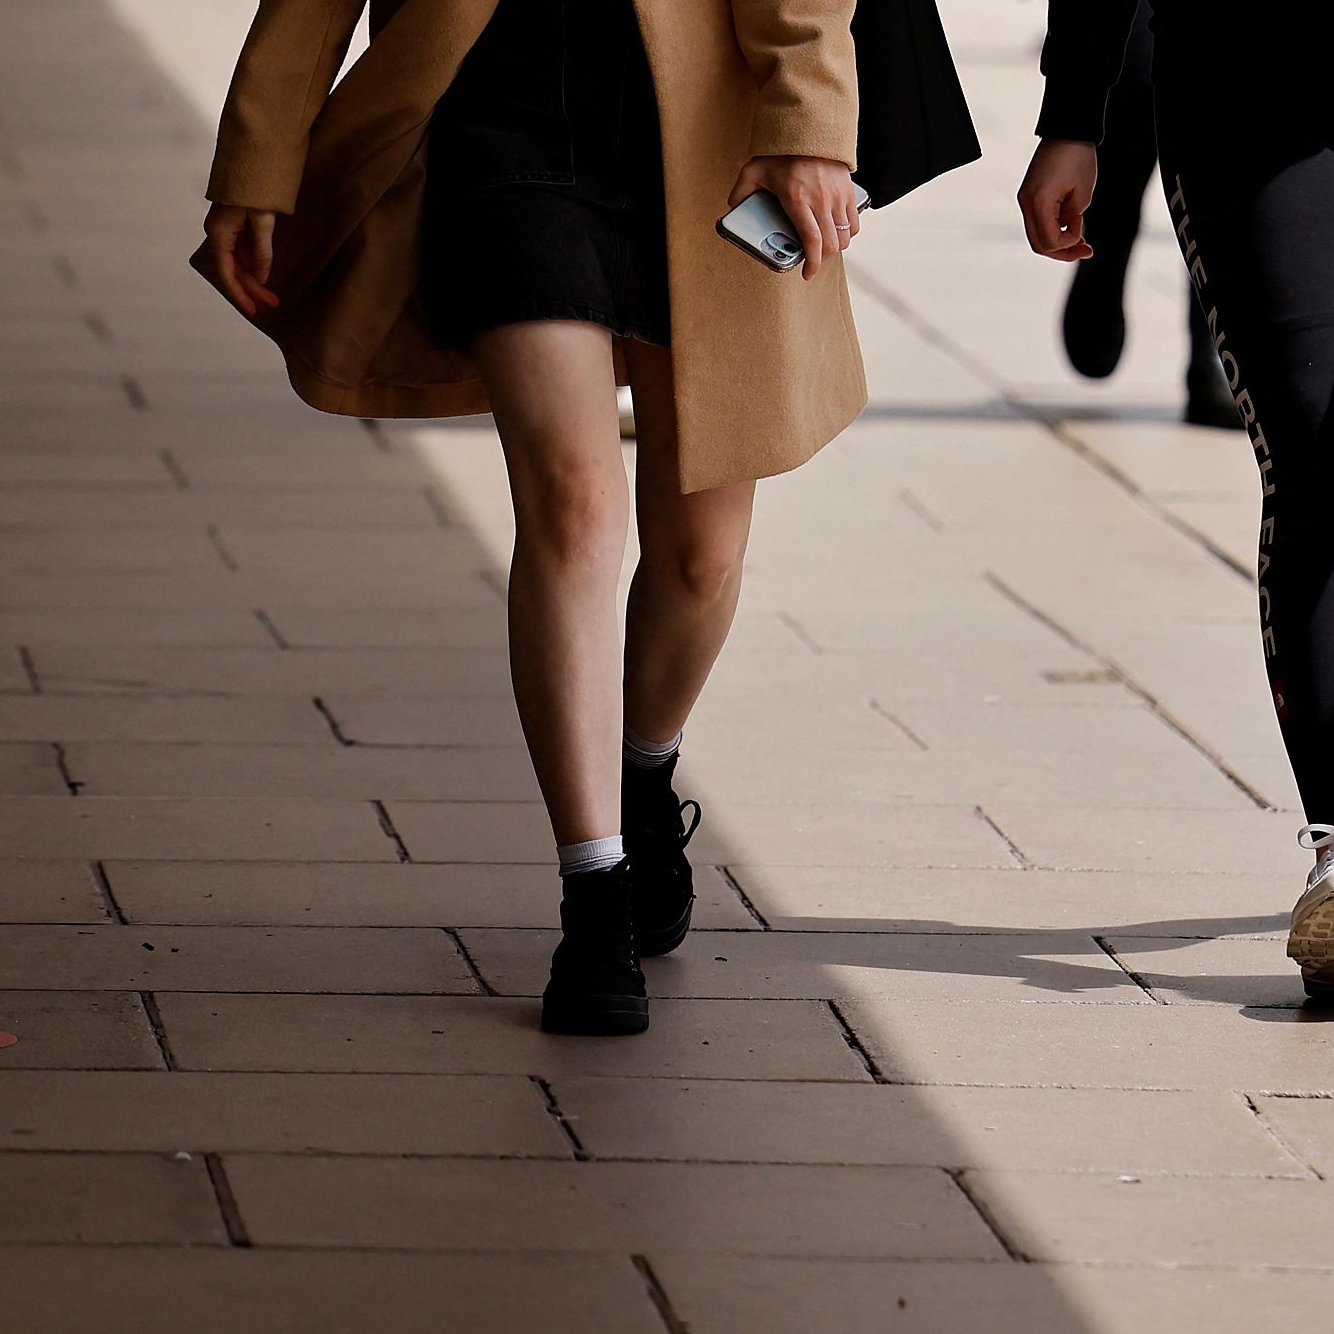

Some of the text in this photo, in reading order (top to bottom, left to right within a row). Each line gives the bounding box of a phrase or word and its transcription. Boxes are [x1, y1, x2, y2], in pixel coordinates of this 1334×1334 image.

[1170, 174, 1277, 659] THE NORTH FACE
